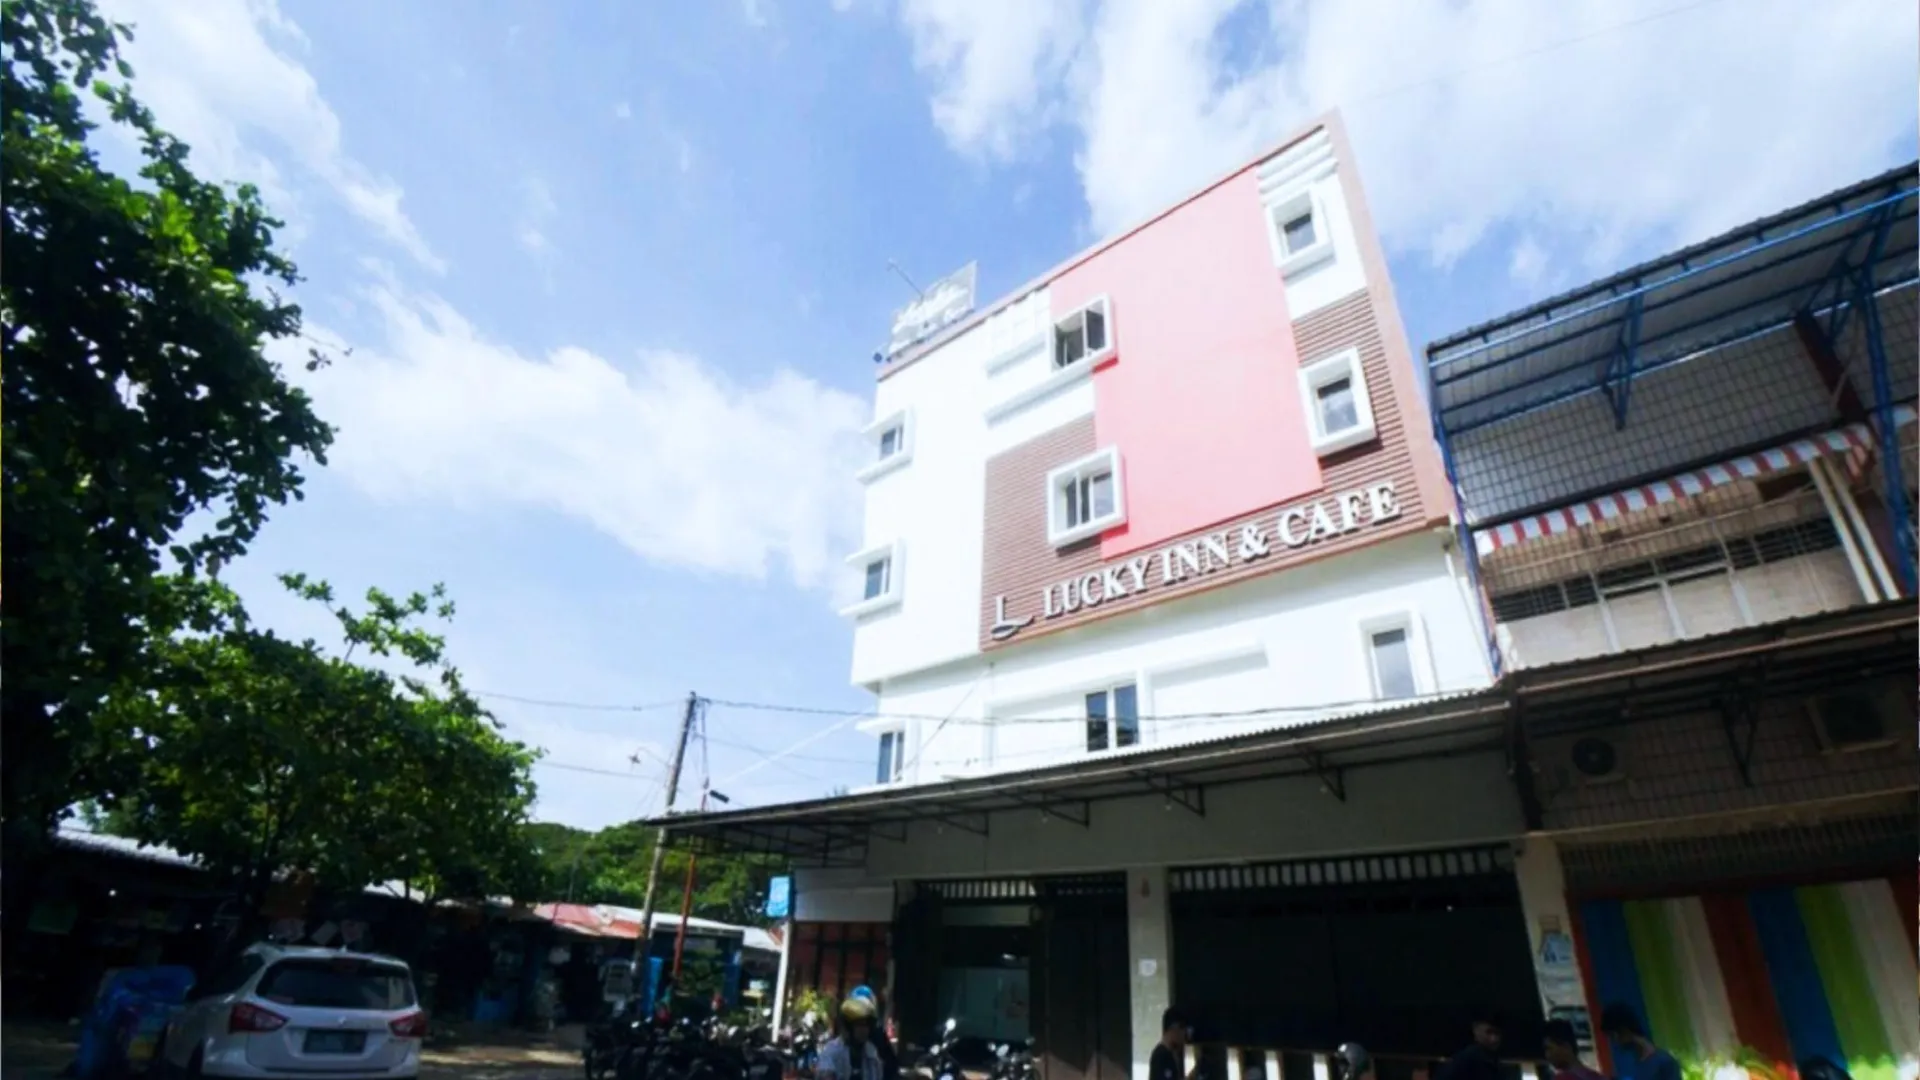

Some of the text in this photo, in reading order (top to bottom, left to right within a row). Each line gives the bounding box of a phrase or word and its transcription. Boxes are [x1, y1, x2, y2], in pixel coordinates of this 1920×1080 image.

[1043, 555, 1152, 617] LUCKY
[1162, 531, 1232, 583] INN
[1237, 524, 1270, 561] &
[1278, 482, 1401, 547] CAFE
